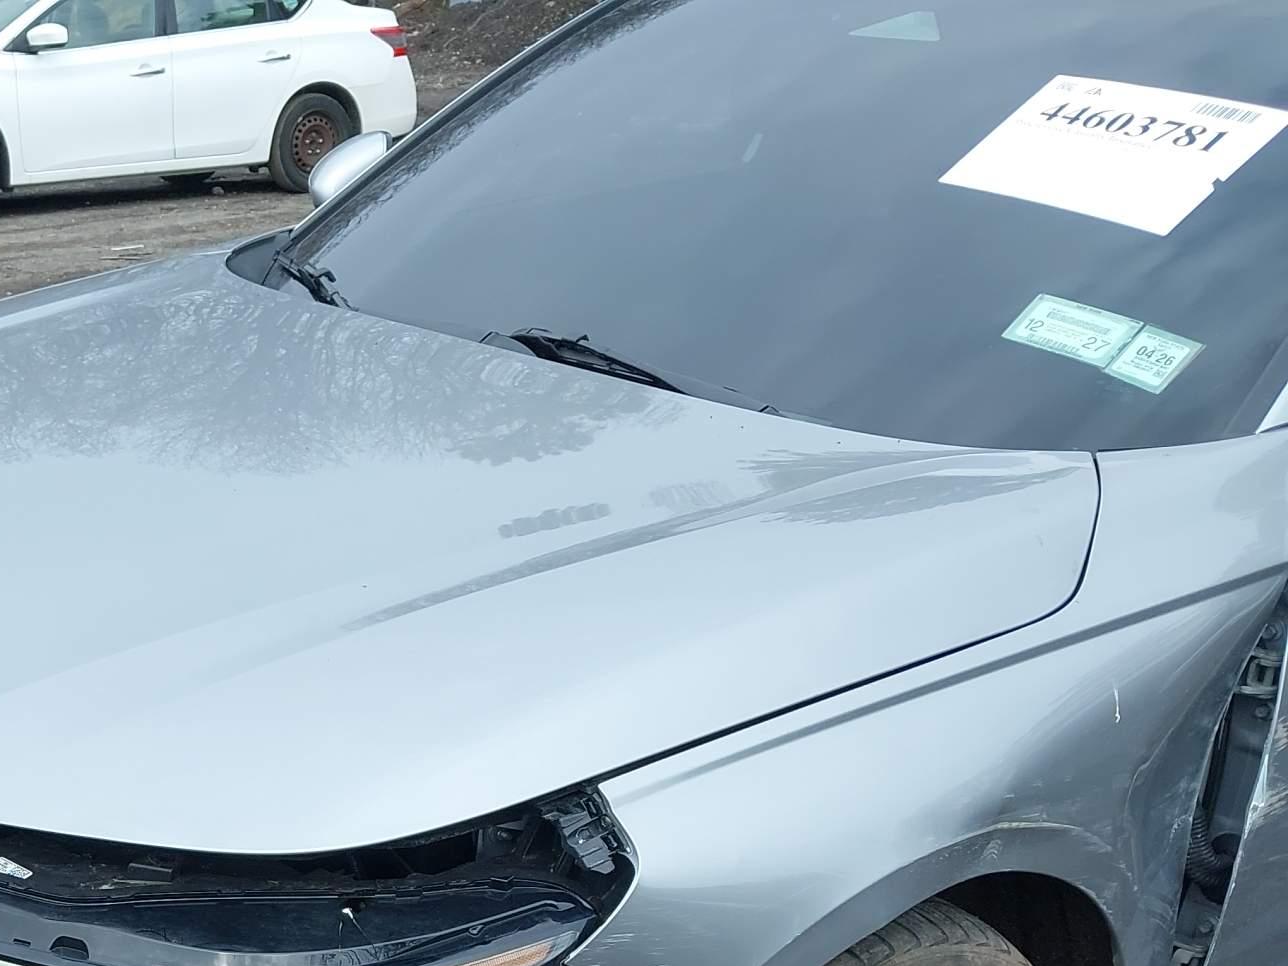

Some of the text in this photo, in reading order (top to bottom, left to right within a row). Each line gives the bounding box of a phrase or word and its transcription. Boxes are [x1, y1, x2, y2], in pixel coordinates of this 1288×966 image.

[1039, 101, 1230, 153] 44603781
[1024, 317, 1045, 333] 12
[1081, 336, 1112, 353] 27
